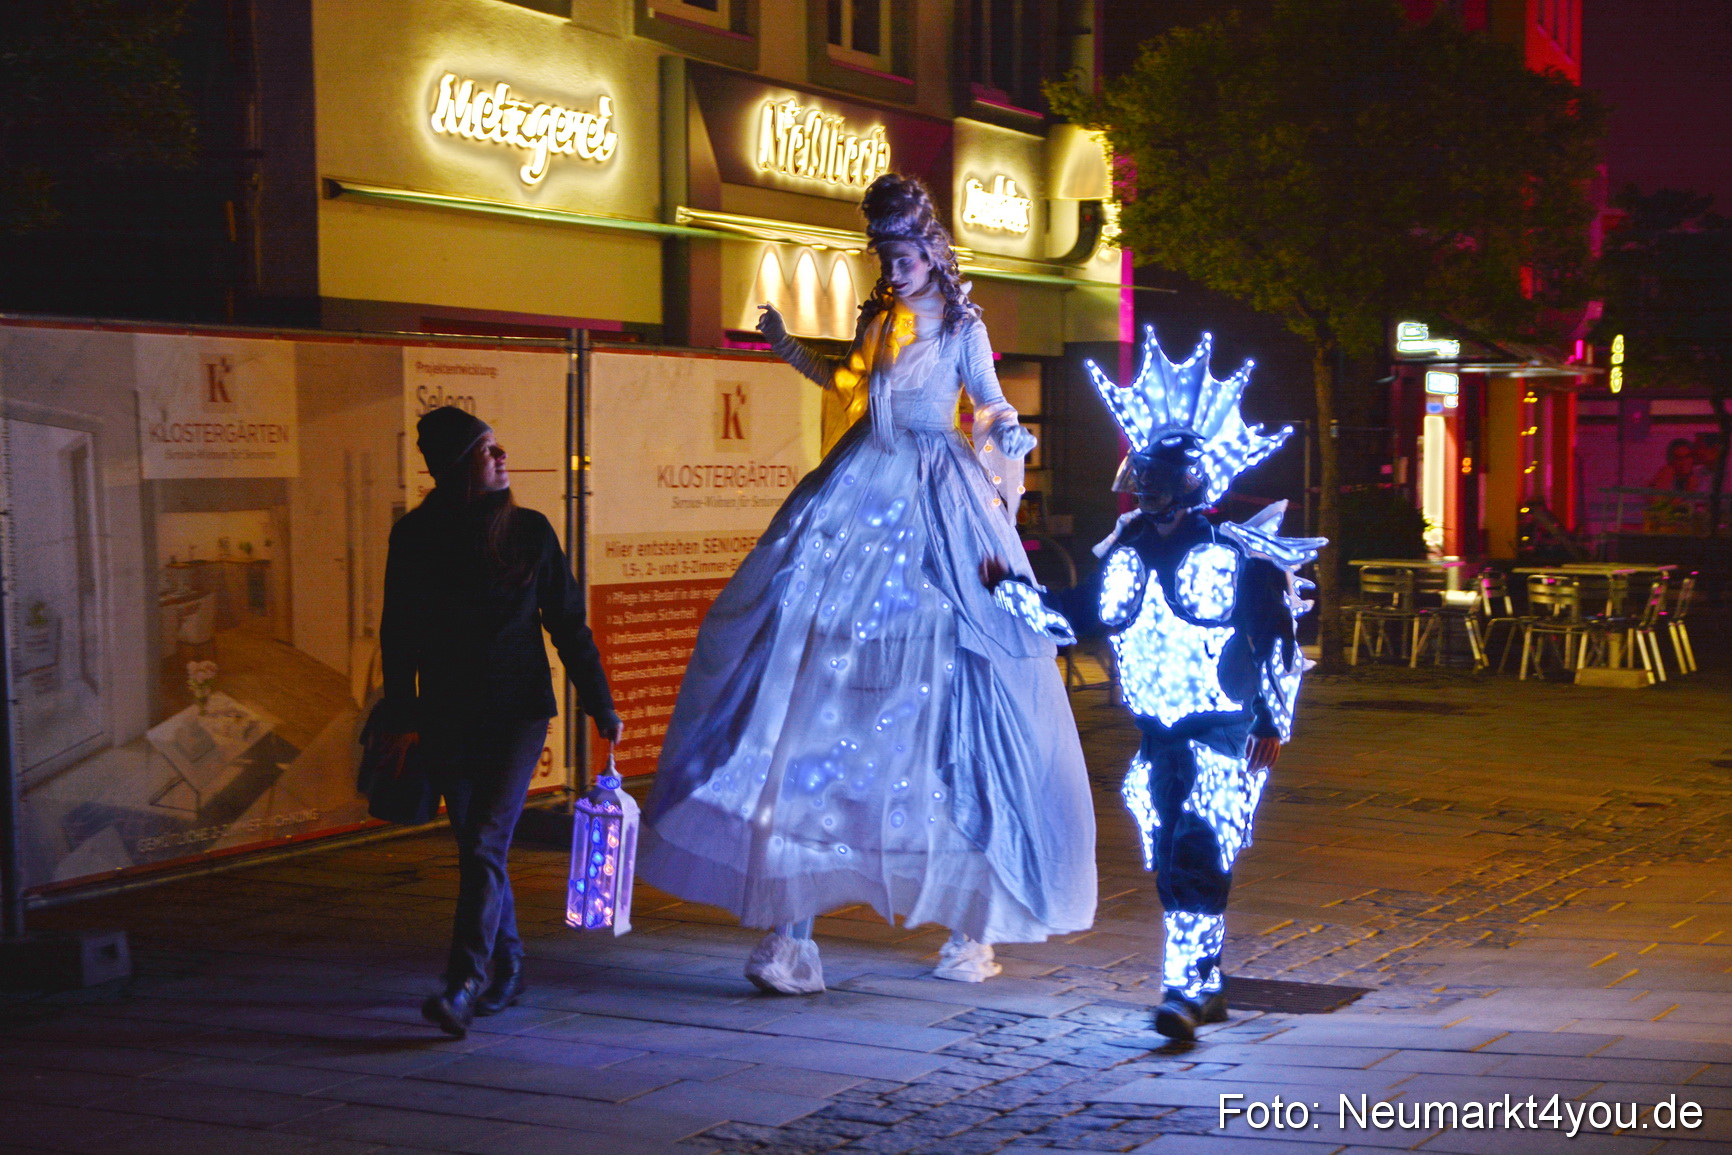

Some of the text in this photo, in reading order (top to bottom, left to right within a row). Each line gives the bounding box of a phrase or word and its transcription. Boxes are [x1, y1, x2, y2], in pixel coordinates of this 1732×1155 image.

[430, 73, 619, 185] Metzgerei
[149, 420, 289, 444] KLOSTERGÄRTEN
[656, 460, 799, 489] KLOSTERGÄRTEN
[605, 540, 633, 558] Hier
[638, 538, 699, 557] entstehen
[659, 559, 679, 575] und
